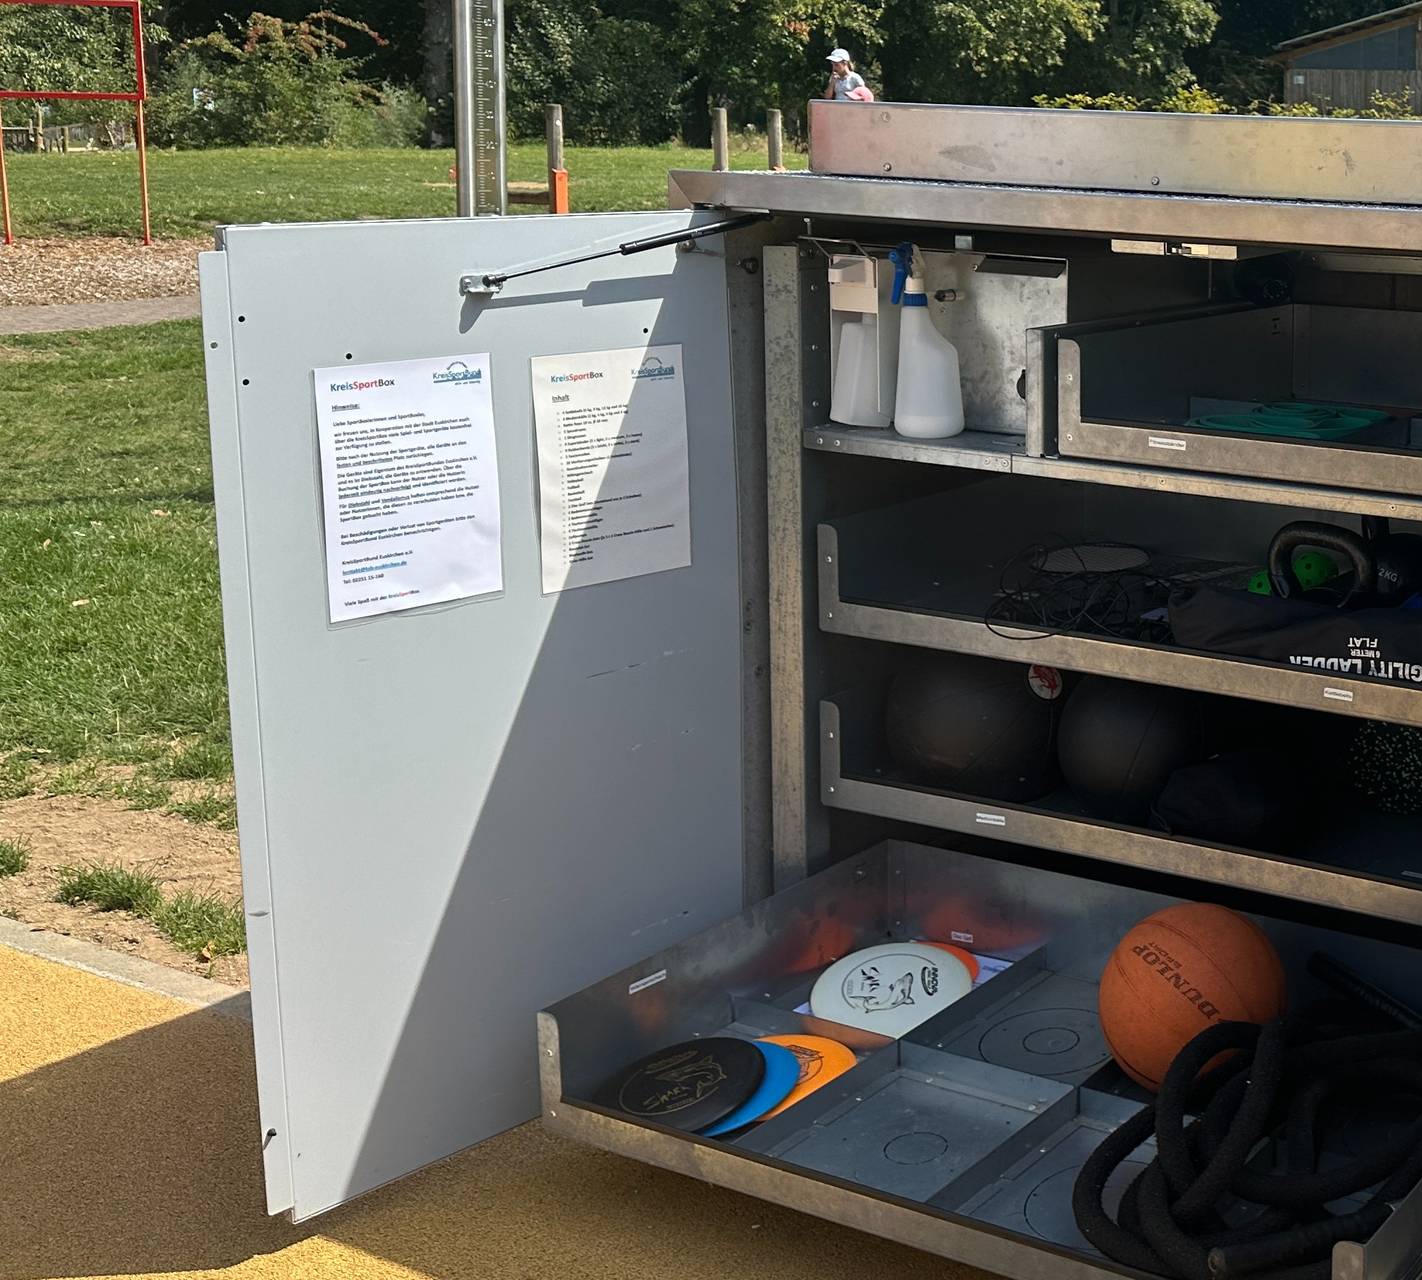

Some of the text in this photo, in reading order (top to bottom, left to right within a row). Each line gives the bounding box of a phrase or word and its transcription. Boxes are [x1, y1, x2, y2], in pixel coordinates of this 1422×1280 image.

[551, 371, 603, 383] KreisSportBox
[330, 379, 395, 392] KreisSportBox
[1347, 637, 1378, 648] FLAT
[1350, 648, 1376, 658] METER
[1131, 944, 1221, 1019] DUNLOP
